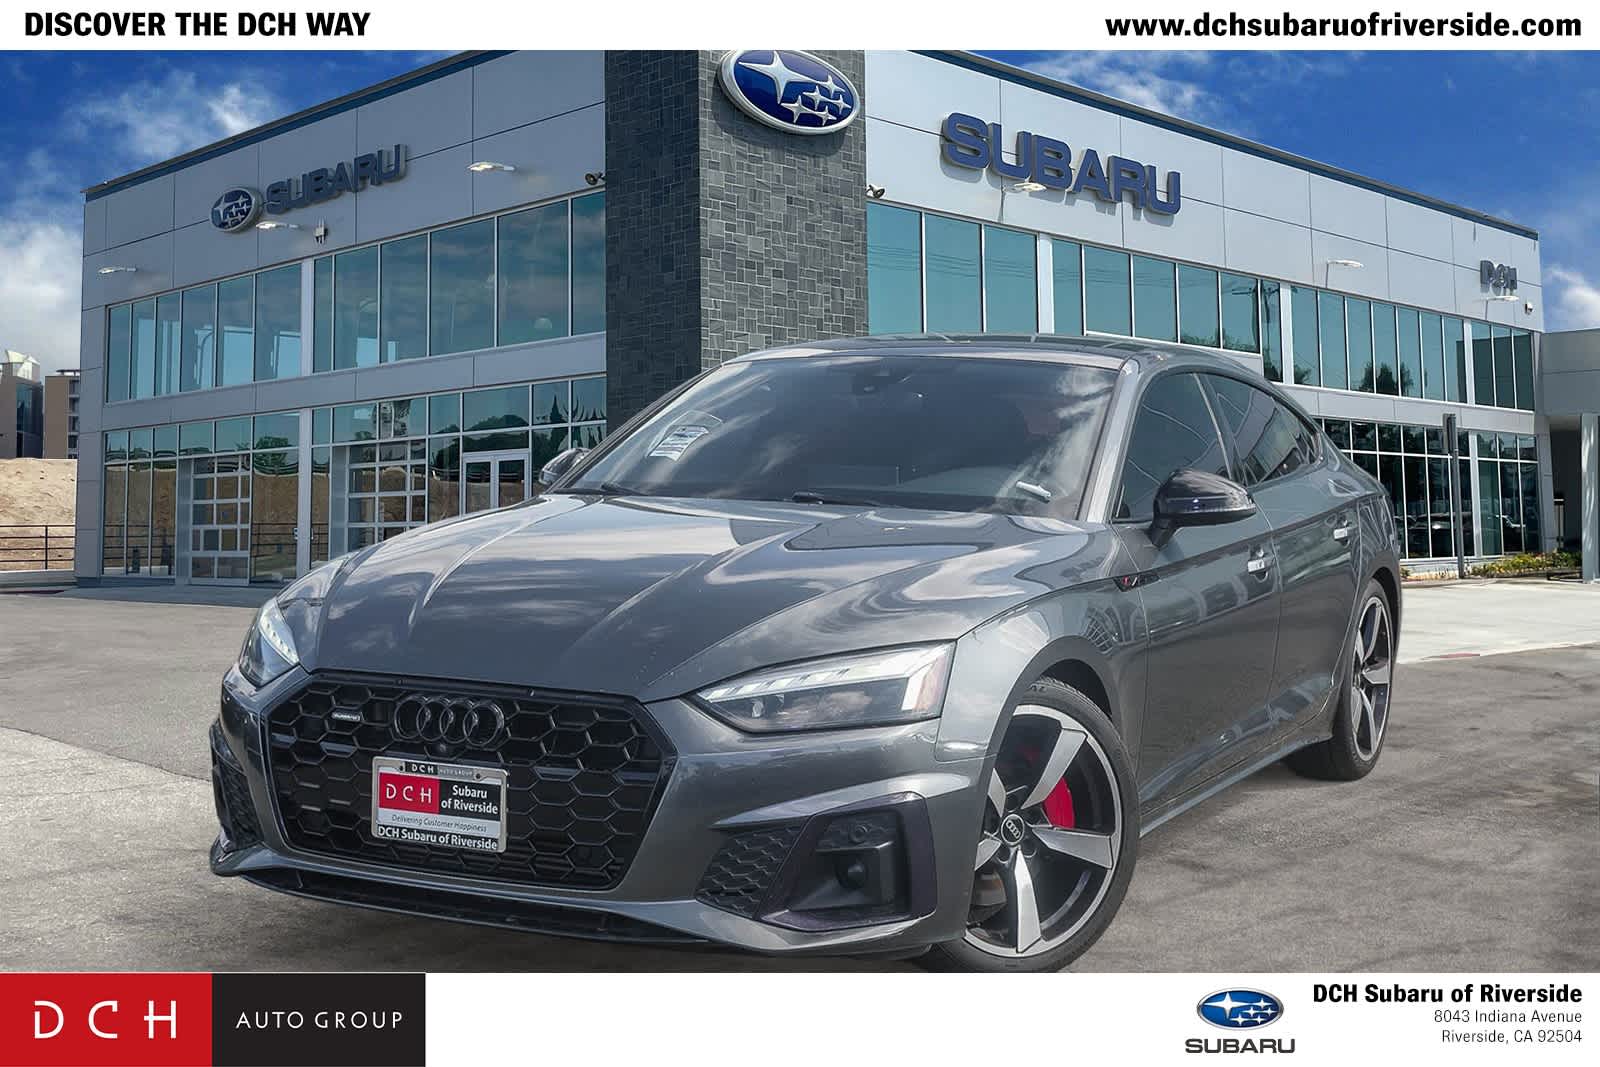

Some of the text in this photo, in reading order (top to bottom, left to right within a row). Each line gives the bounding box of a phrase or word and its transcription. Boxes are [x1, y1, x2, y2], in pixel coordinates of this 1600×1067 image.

[941, 112, 1181, 215] SUBARU
[266, 144, 407, 215] SUBARU
[411, 763, 434, 774] DCH
[385, 783, 432, 804] DCH
[452, 784, 488, 799] Subaru
[440, 798, 499, 815] of Riverside
[391, 814, 487, 833] Delivering Customer Happiness
[378, 826, 498, 850] DCH Subaru of Riverside
